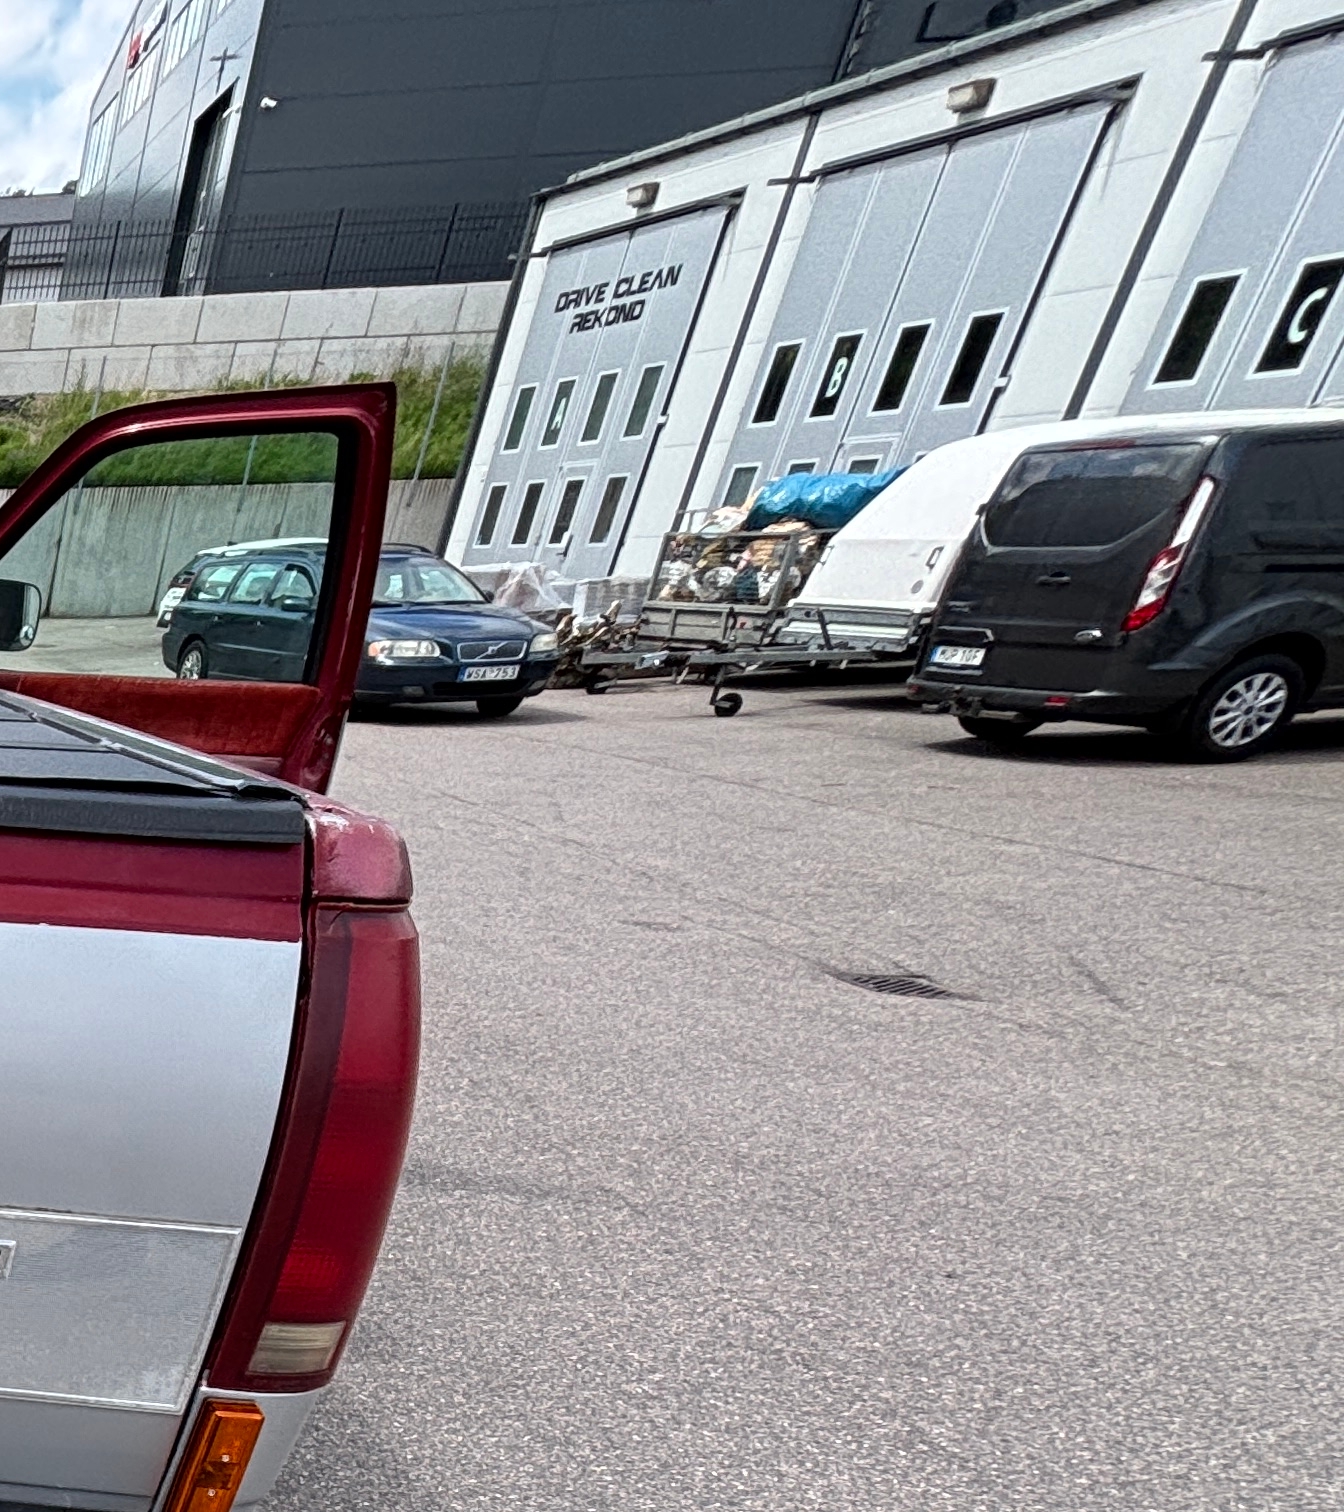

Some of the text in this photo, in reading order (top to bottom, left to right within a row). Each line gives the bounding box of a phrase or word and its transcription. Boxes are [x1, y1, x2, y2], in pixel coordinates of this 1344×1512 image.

[554, 263, 683, 313] DRIVE CLEAN
[569, 299, 646, 334] REKOND
[1287, 287, 1328, 343] C
[824, 357, 848, 397] B
[550, 397, 567, 430] A
[493, 667, 517, 678] 753
